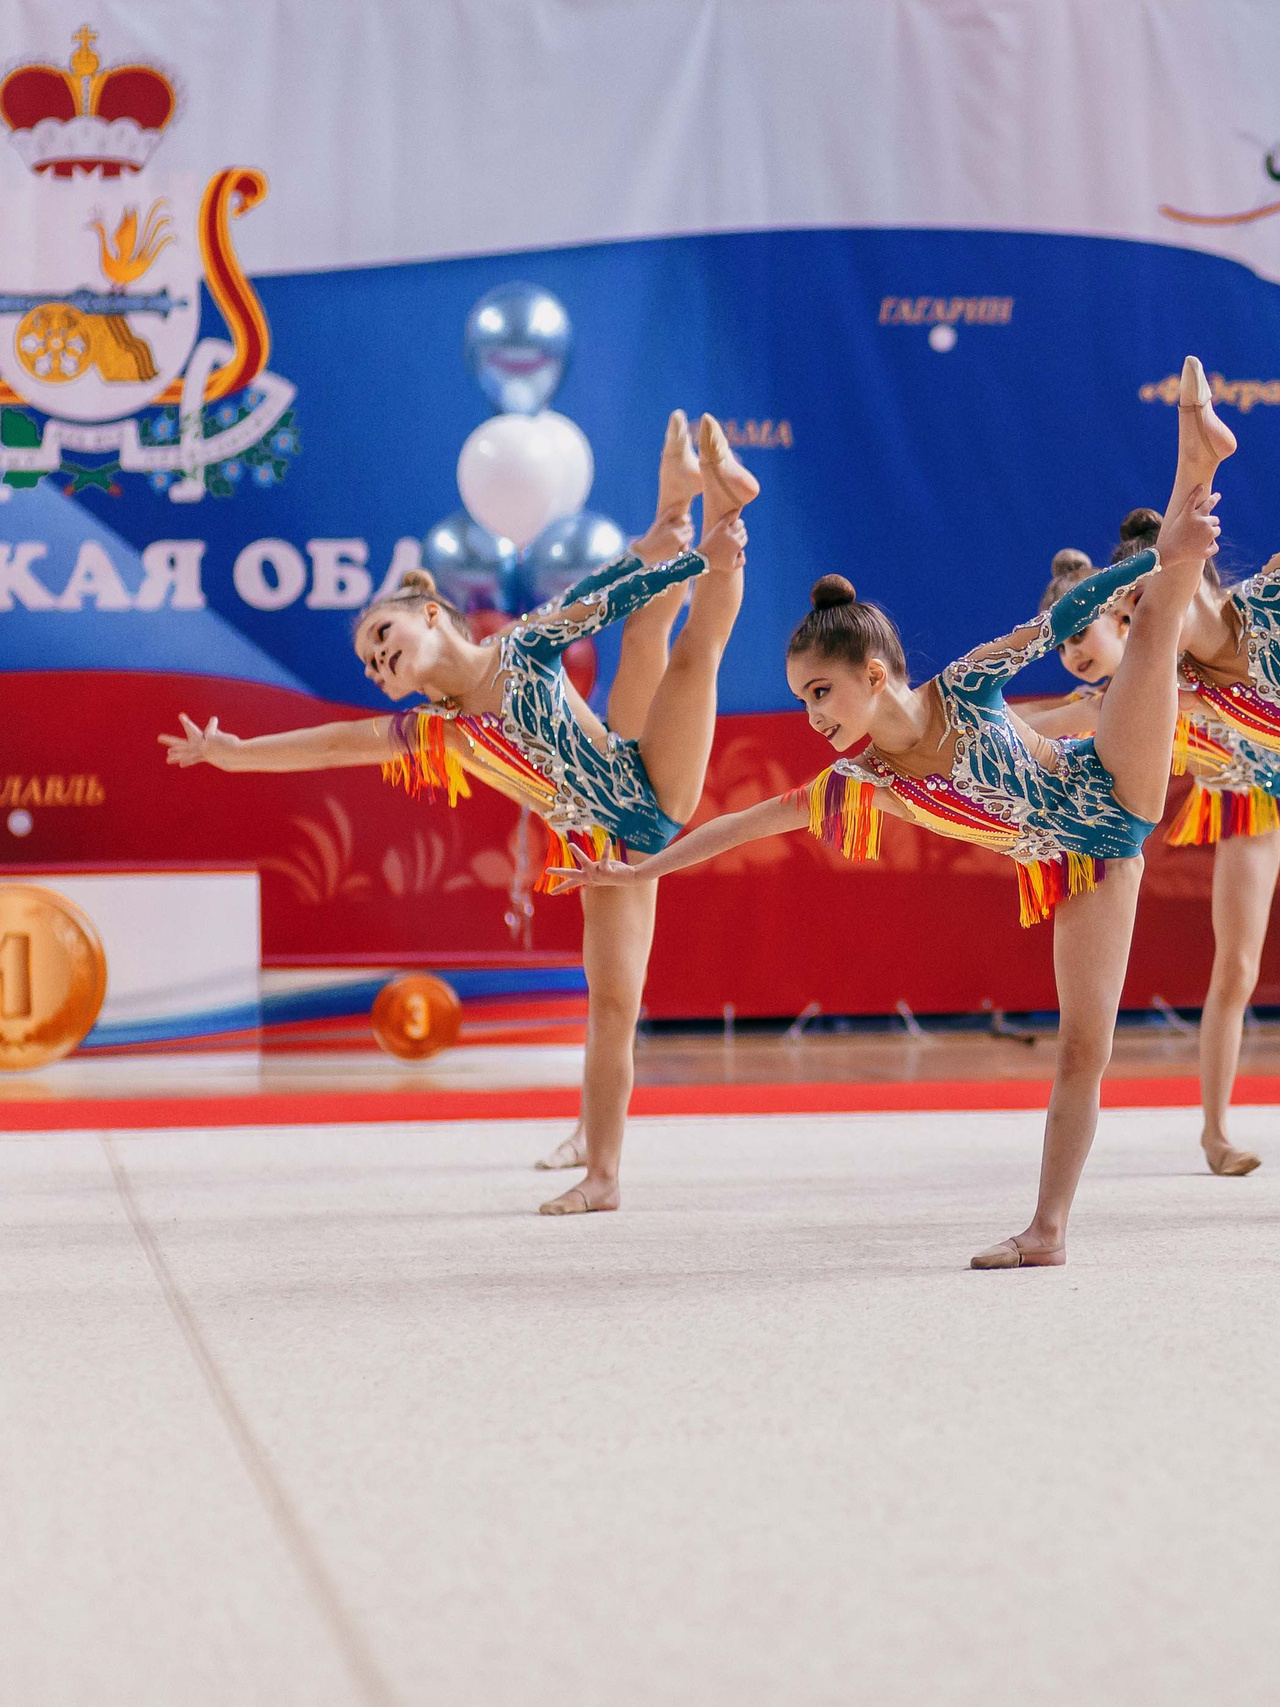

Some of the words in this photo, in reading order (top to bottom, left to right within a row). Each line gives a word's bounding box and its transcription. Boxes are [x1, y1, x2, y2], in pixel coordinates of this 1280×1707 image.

[879, 296, 1014, 325] ГАГАРИН
[0, 540, 206, 611] КАЯ
[404, 993, 430, 1039] 3
